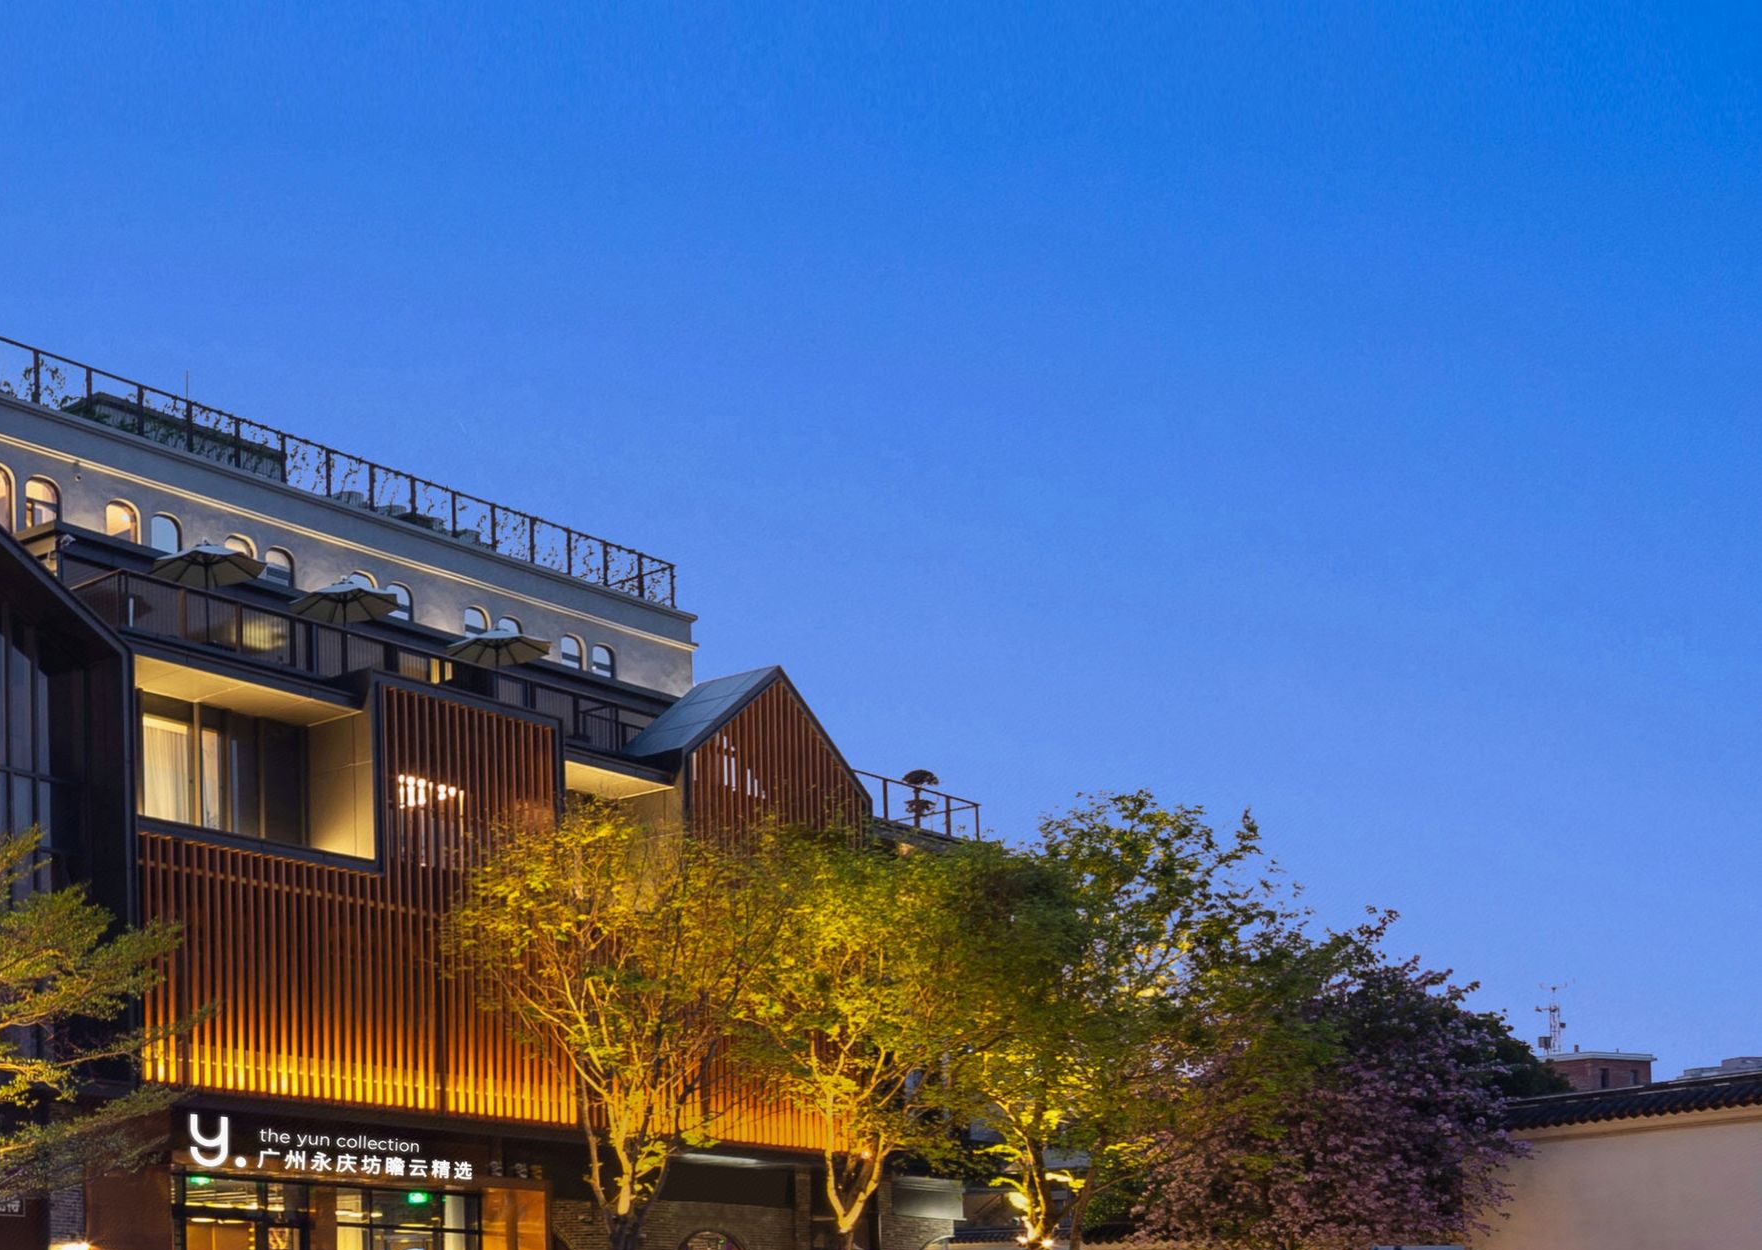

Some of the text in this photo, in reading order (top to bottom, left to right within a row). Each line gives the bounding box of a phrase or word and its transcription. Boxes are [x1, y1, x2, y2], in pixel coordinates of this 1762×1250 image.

[259, 1127, 420, 1153] the yun collection
[257, 1149, 473, 1181] 广州永庆坊瞻云精选
